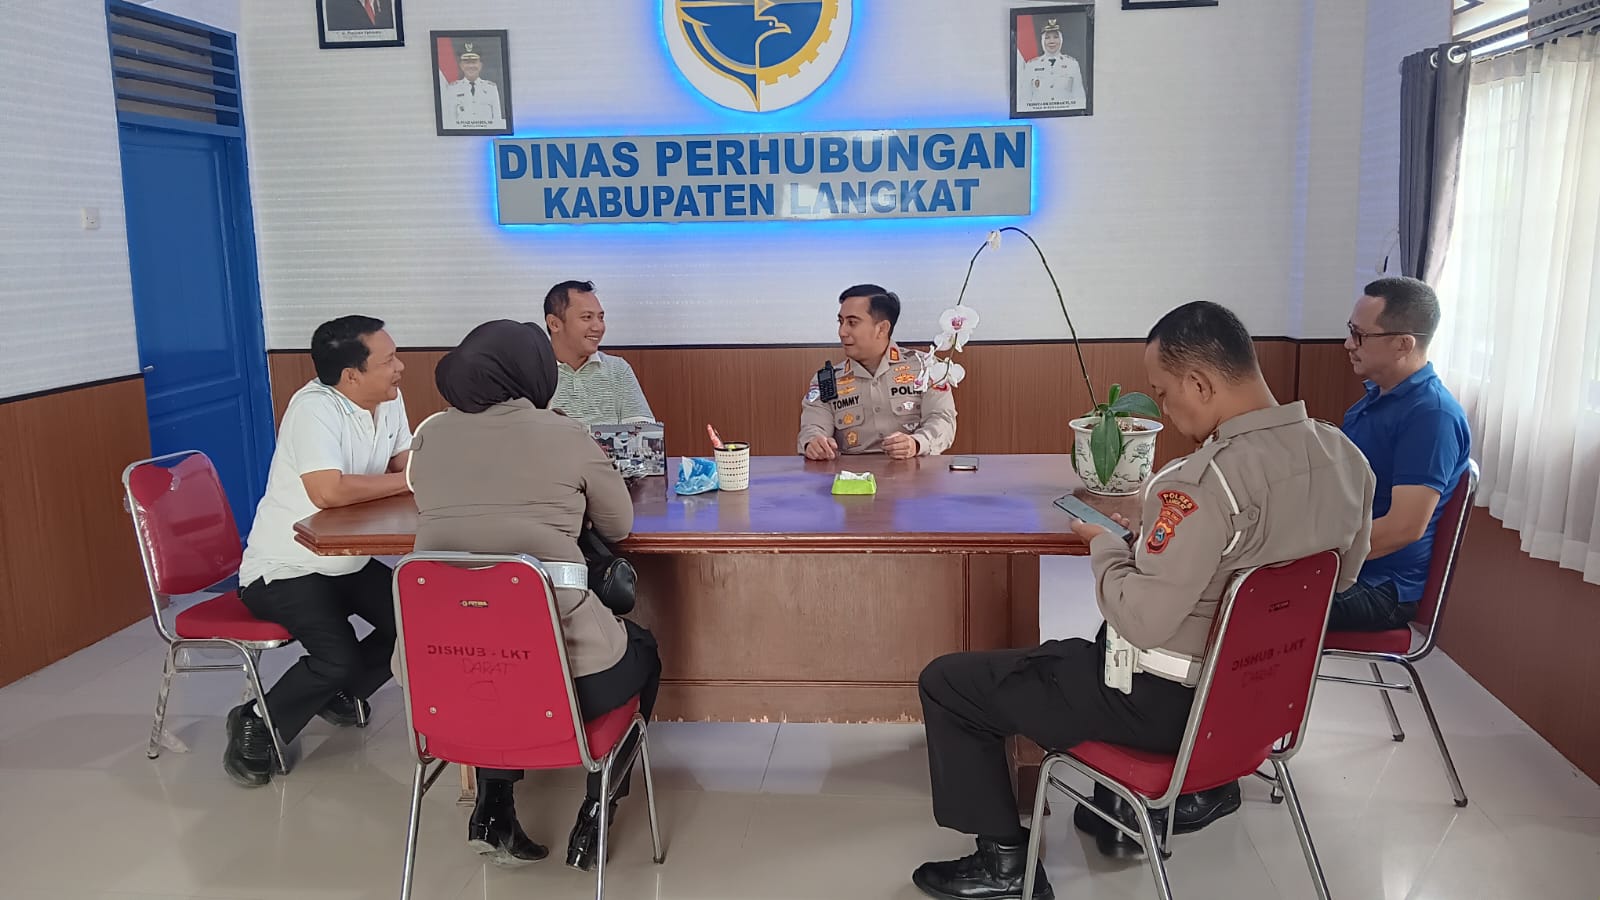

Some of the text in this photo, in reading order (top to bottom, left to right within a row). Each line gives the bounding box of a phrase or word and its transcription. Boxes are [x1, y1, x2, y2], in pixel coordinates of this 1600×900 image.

[499, 131, 1026, 179] DINAS PERHUBUNGAN
[543, 177, 980, 219] KABUPATEN LANGKAT
[832, 396, 860, 410] TOMMY
[1163, 492, 1193, 510] POLRES
[427, 644, 486, 657] DISHUB
[501, 649, 531, 660] LKT
